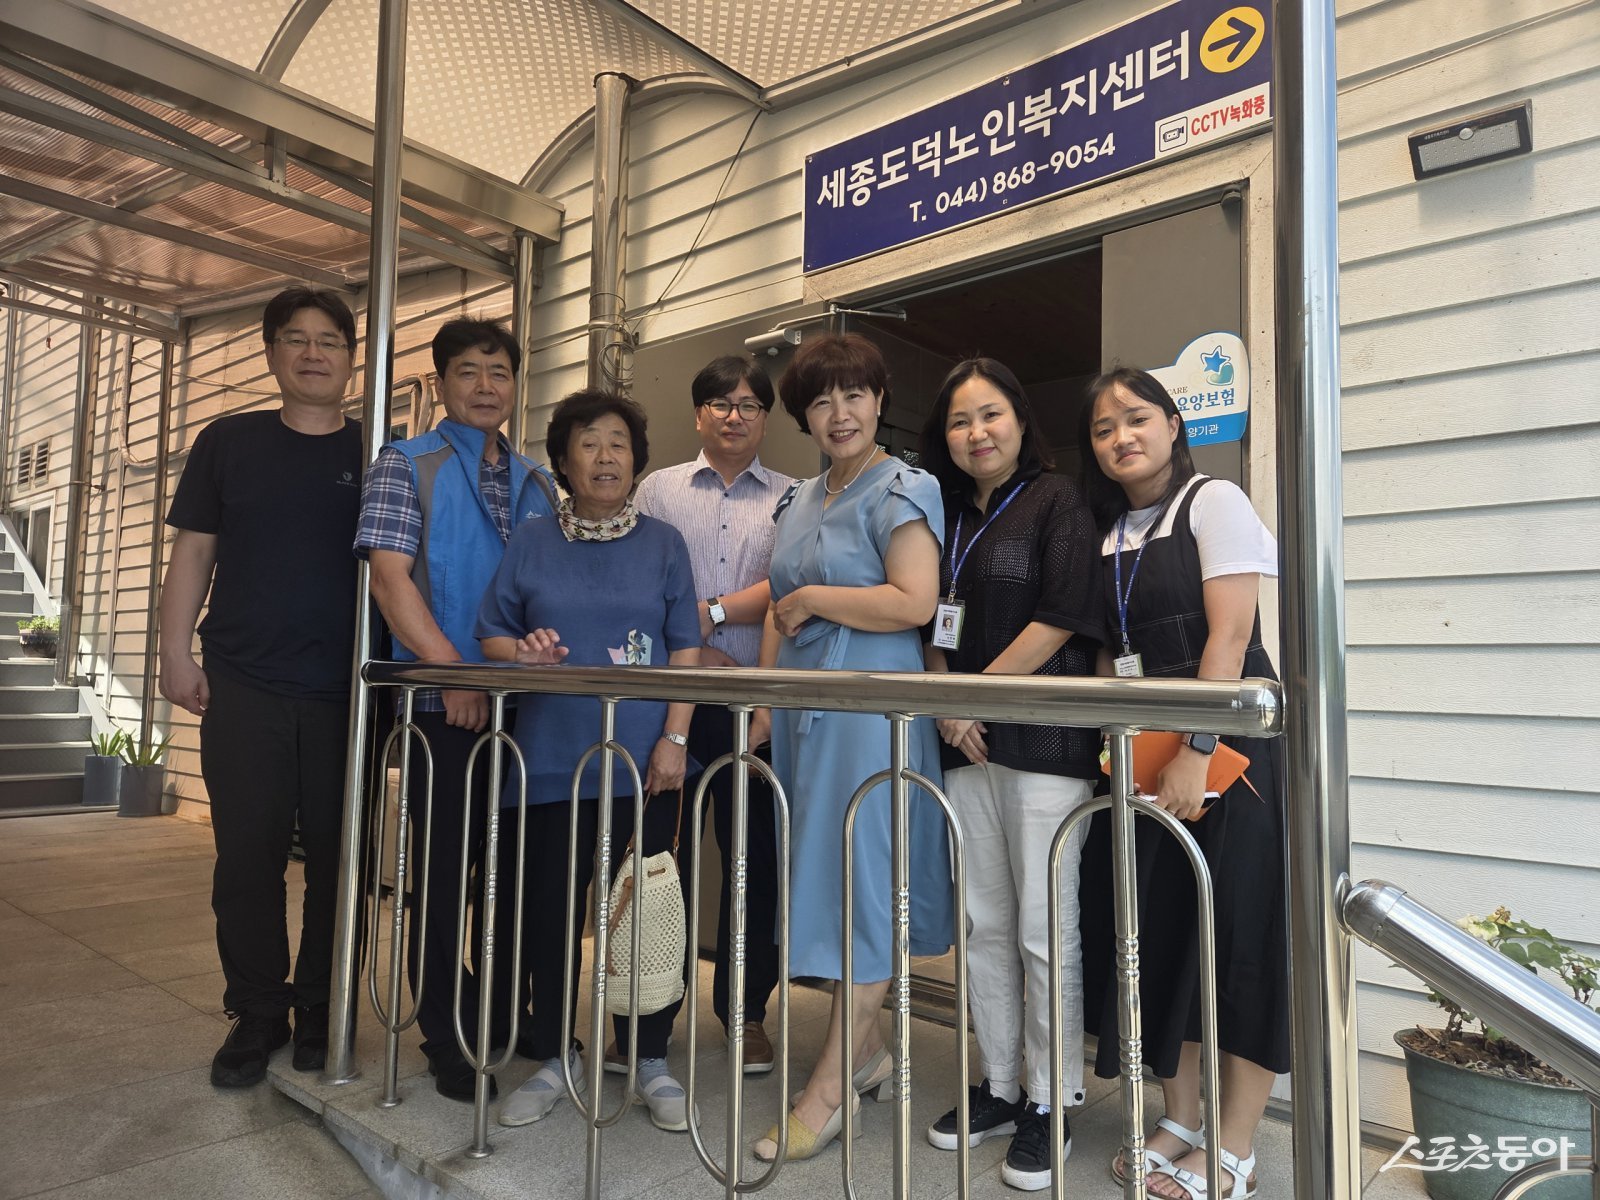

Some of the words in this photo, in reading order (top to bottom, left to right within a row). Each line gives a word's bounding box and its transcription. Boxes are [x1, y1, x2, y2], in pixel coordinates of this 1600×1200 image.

[817, 30, 1190, 208] 세종도덕노인복지센터
[1191, 94, 1265, 136] CCTV녹화중
[909, 200, 927, 222] T.
[1185, 424, 1219, 438] 양기관
